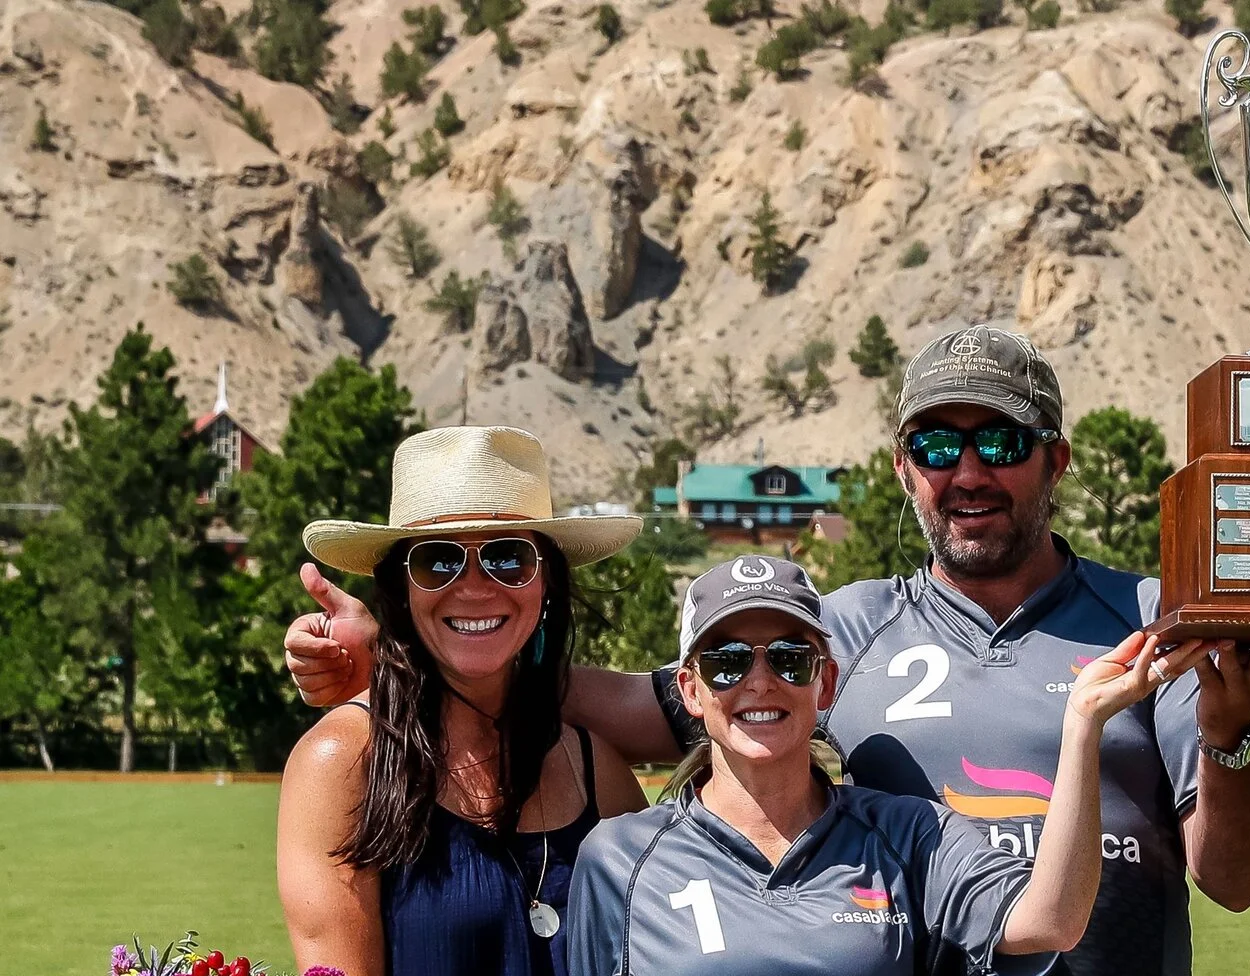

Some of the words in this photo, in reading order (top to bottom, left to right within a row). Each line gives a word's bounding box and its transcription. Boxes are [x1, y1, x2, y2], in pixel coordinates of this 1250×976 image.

[885, 643, 953, 723] 2
[668, 879, 726, 954] 1
[832, 910, 909, 925] casablaca
